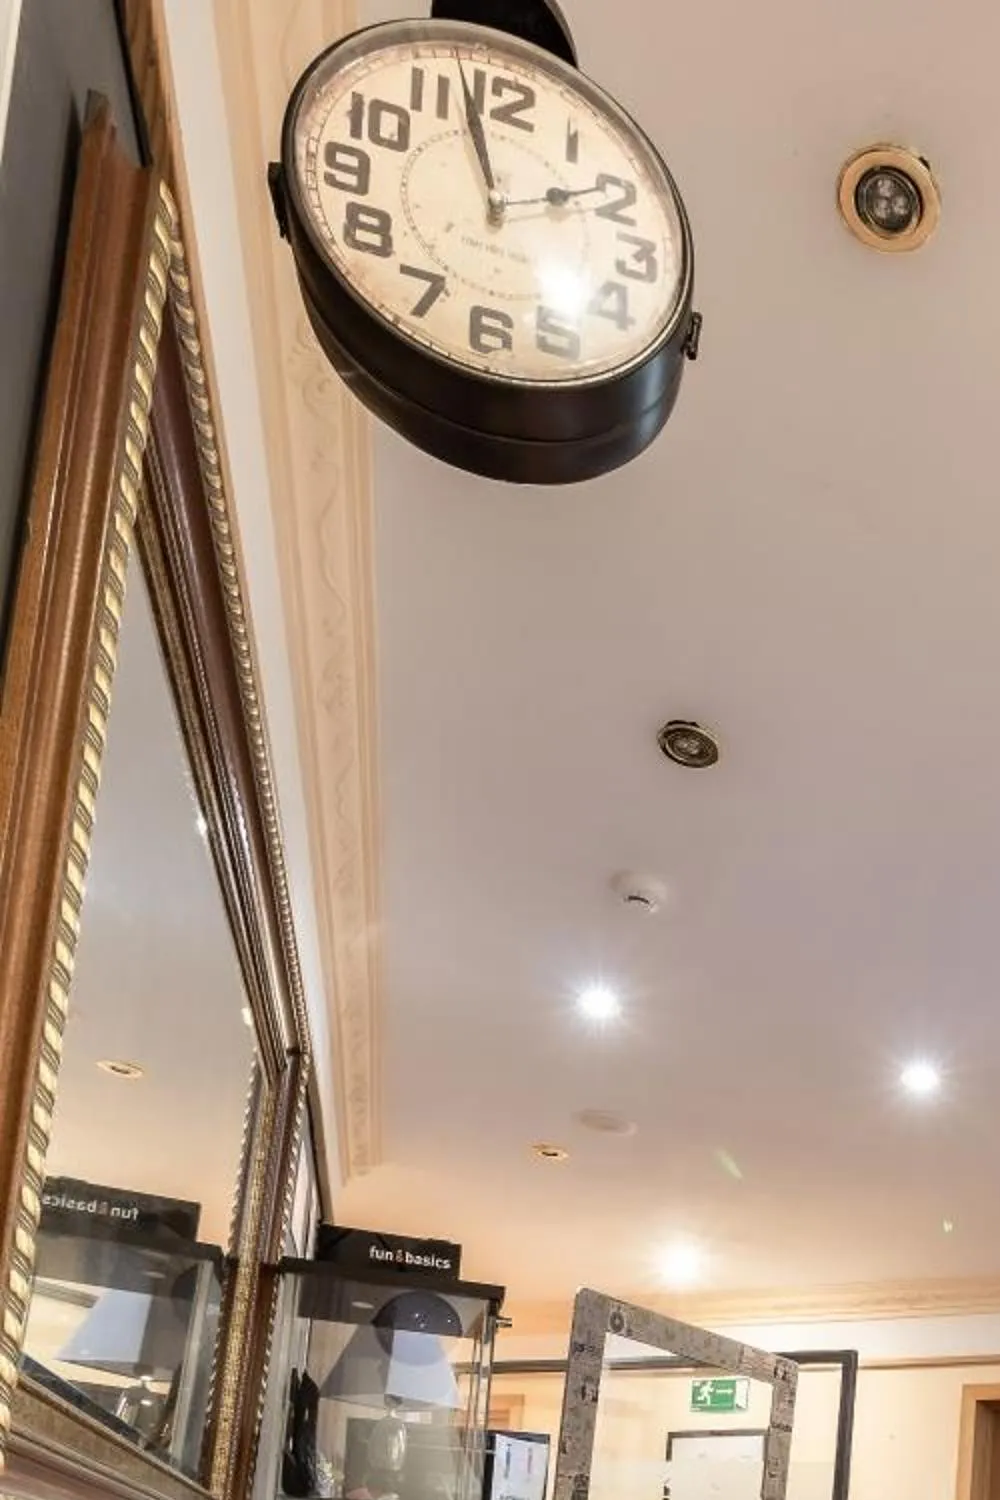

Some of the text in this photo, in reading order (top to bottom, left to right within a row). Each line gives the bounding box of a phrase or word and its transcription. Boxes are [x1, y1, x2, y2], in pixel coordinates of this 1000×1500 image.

[410, 66, 450, 120] 11
[470, 69, 536, 133] 12
[347, 91, 411, 153] 10
[565, 116, 579, 163] 1
[323, 141, 371, 196] 9
[594, 172, 637, 227] 2
[343, 201, 394, 259] 8
[615, 232, 658, 283] 3
[399, 263, 447, 319] 7
[587, 281, 635, 331] 4
[469, 305, 514, 354] 6
[536, 305, 581, 360] 5
